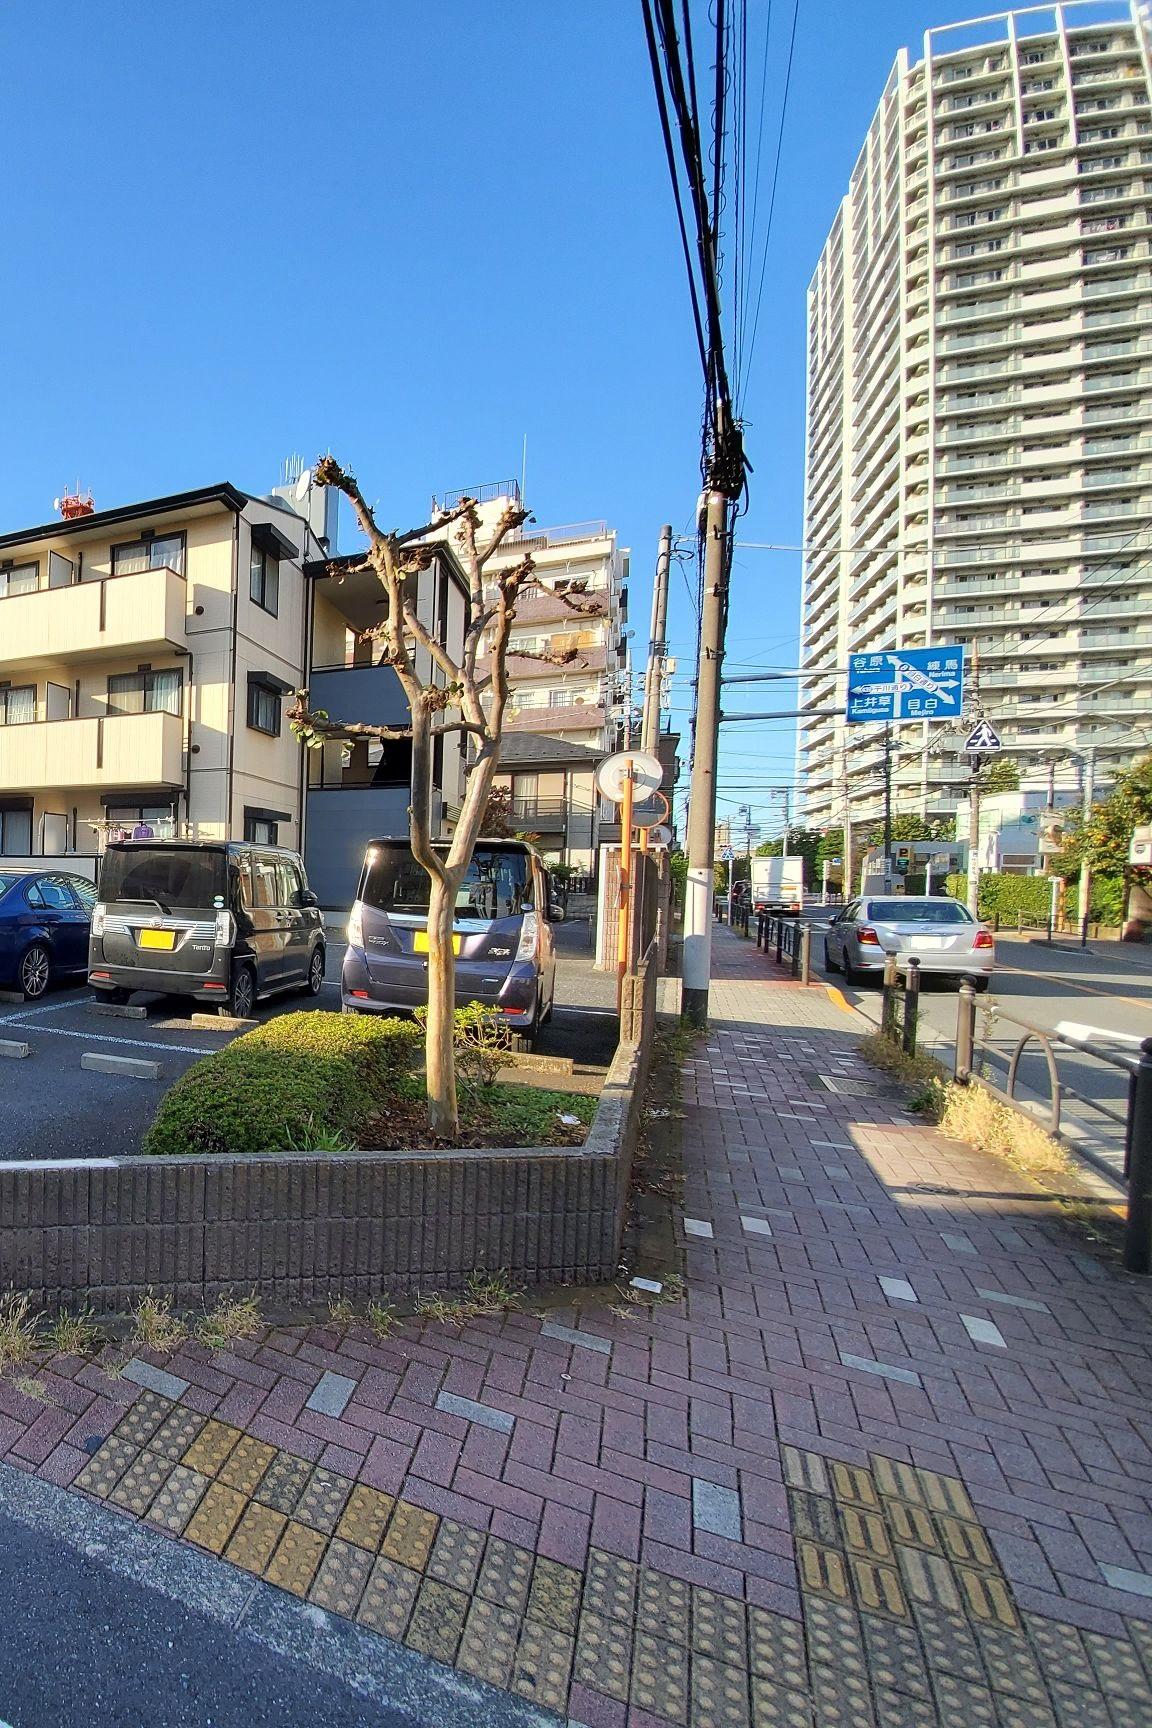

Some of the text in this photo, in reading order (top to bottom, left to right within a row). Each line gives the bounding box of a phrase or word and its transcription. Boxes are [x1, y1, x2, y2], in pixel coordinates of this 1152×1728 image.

[853, 655, 883, 668] 谷原
[926, 659, 957, 670] 練馬
[850, 695, 891, 709] 上井草
[907, 698, 937, 710] 目白
[910, 709, 934, 717] Mejiro
